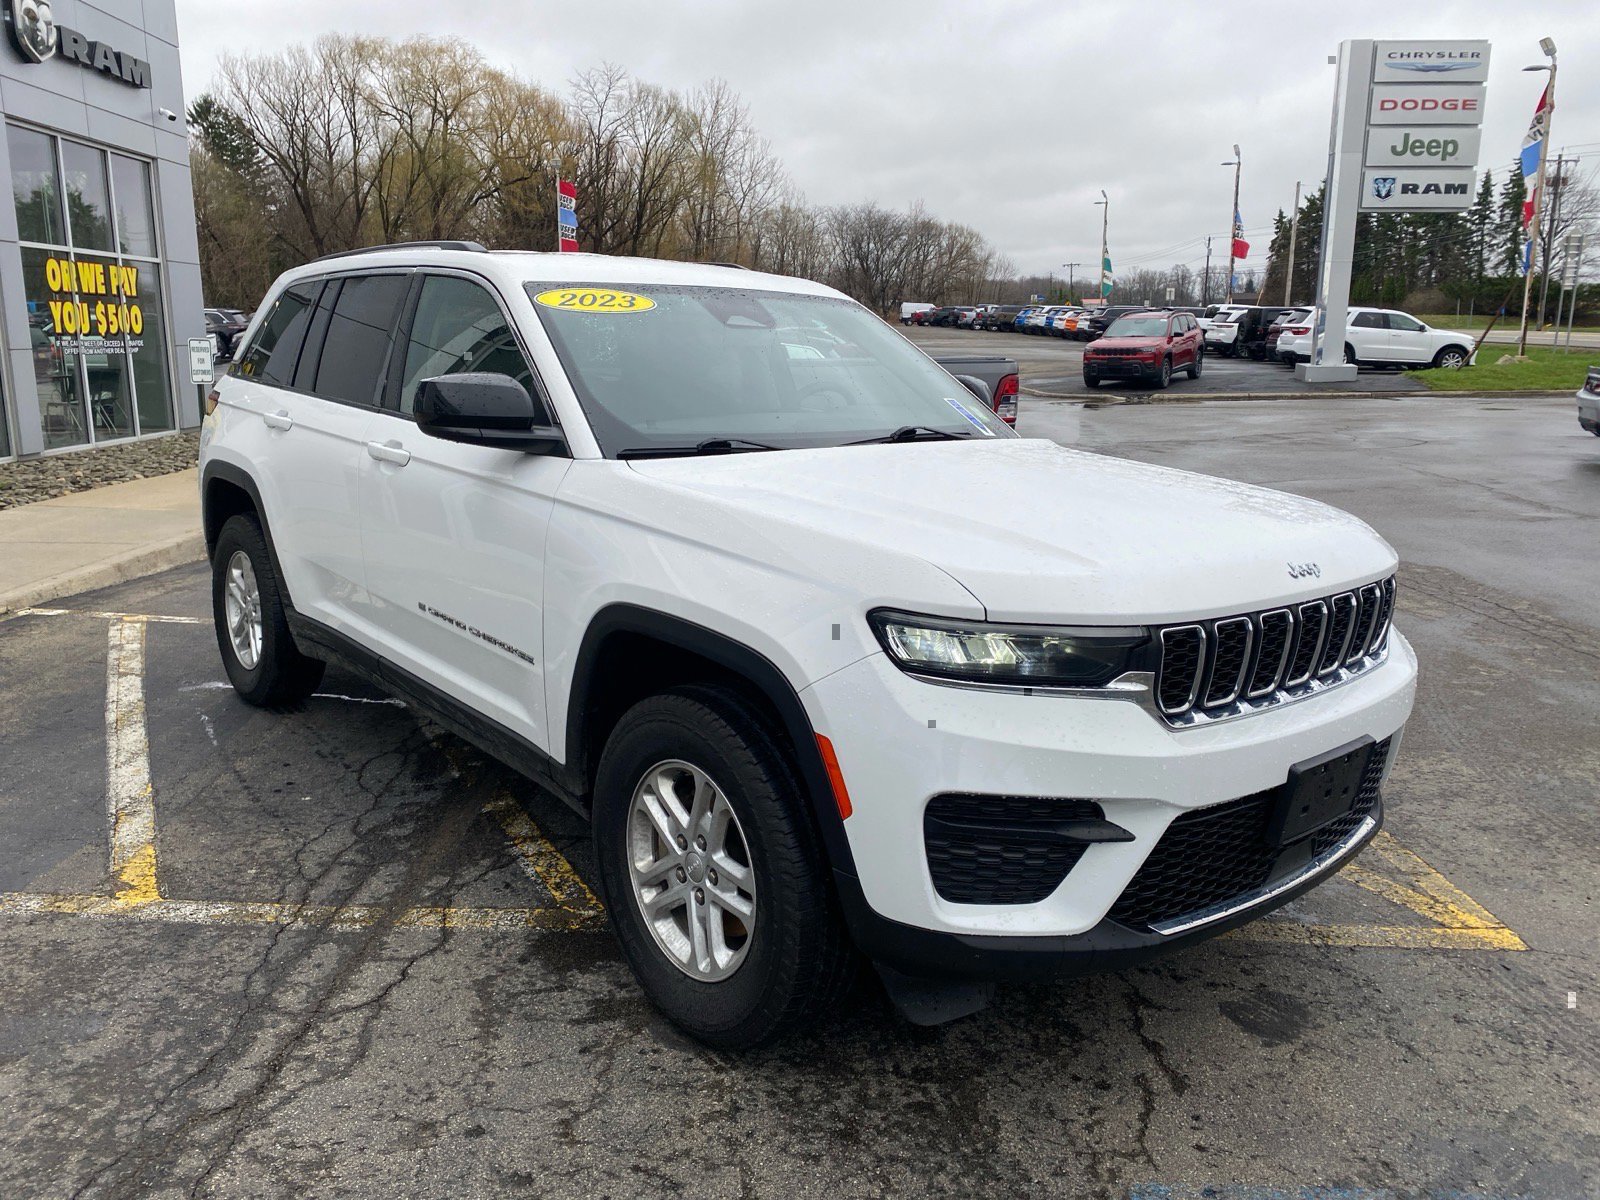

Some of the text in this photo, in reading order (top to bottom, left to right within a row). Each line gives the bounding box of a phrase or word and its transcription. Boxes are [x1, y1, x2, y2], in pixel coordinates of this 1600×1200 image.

[57, 25, 152, 88] RAM
[1388, 51, 1481, 59] CHRYSLER
[1379, 98, 1478, 111] DODGE
[1390, 132, 1459, 161] Jeep
[1400, 183, 1468, 195] RAM
[46, 258, 138, 296] OR WE PAY
[558, 292, 637, 308] 2023
[49, 300, 143, 336] YOU $500
[1286, 561, 1321, 579] Jeep
[468, 626, 535, 666] CHEROKEE
